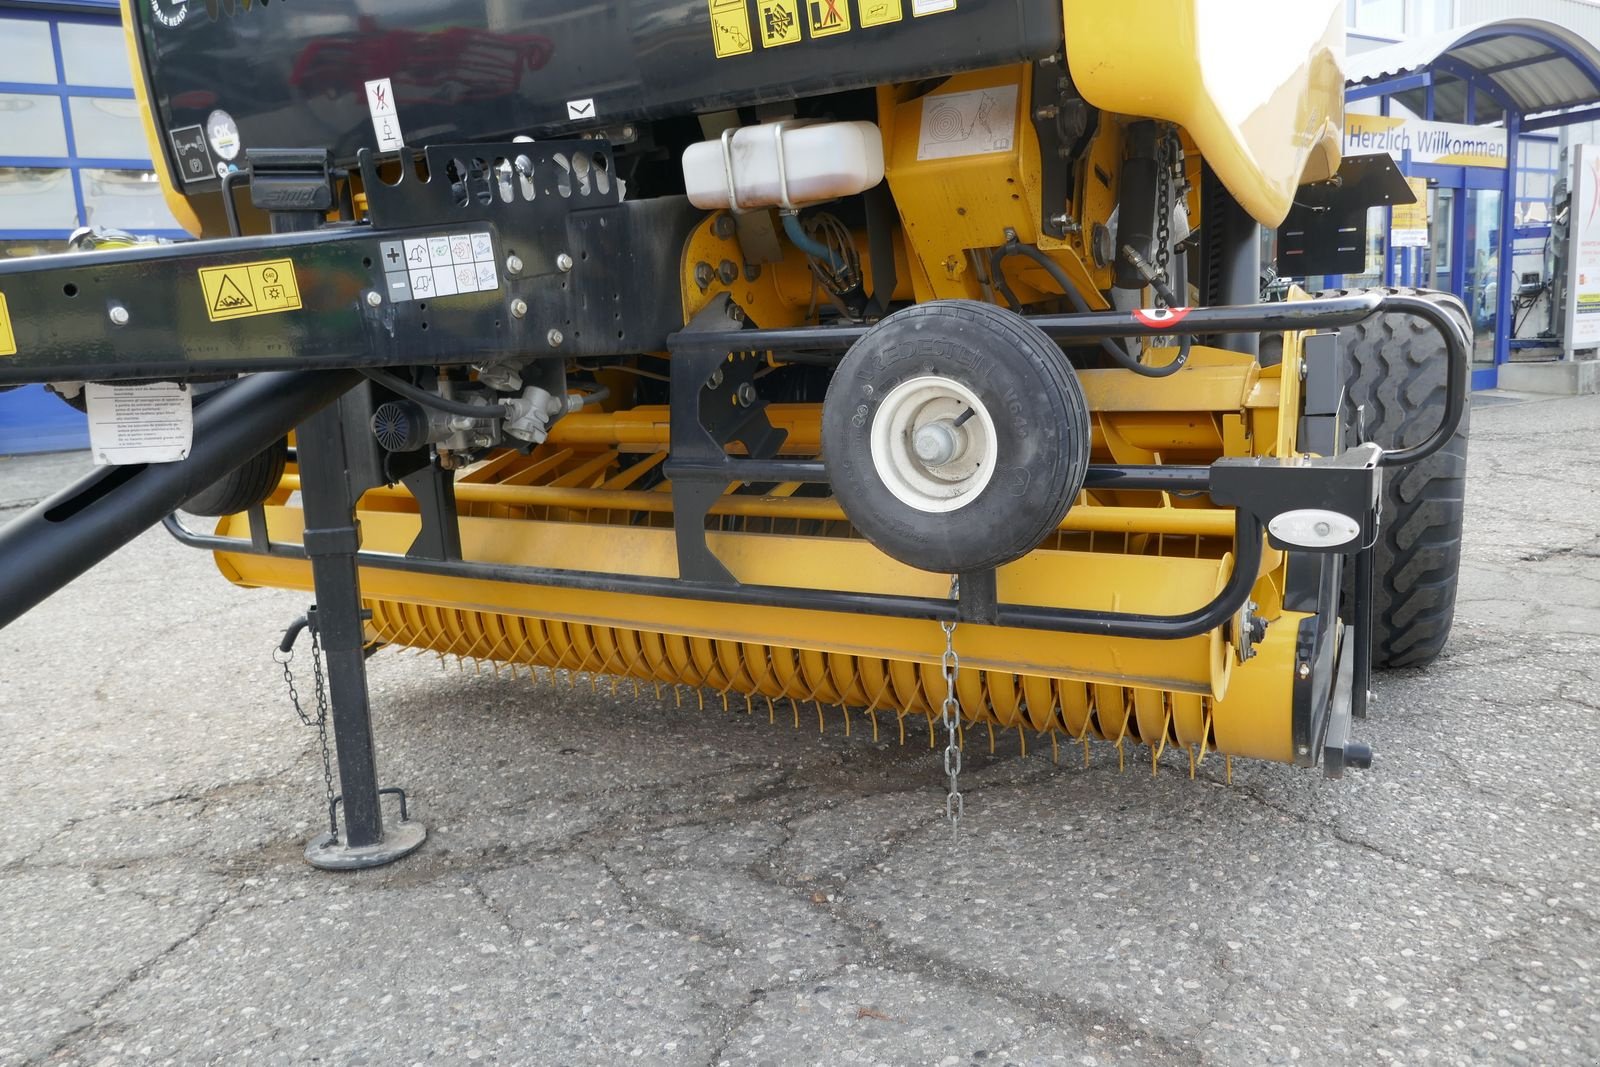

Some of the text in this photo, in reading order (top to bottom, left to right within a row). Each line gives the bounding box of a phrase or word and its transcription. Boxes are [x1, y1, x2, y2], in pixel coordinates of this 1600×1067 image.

[214, 123, 231, 138] OK
[1349, 125, 1504, 159] Herzlich Willkommen
